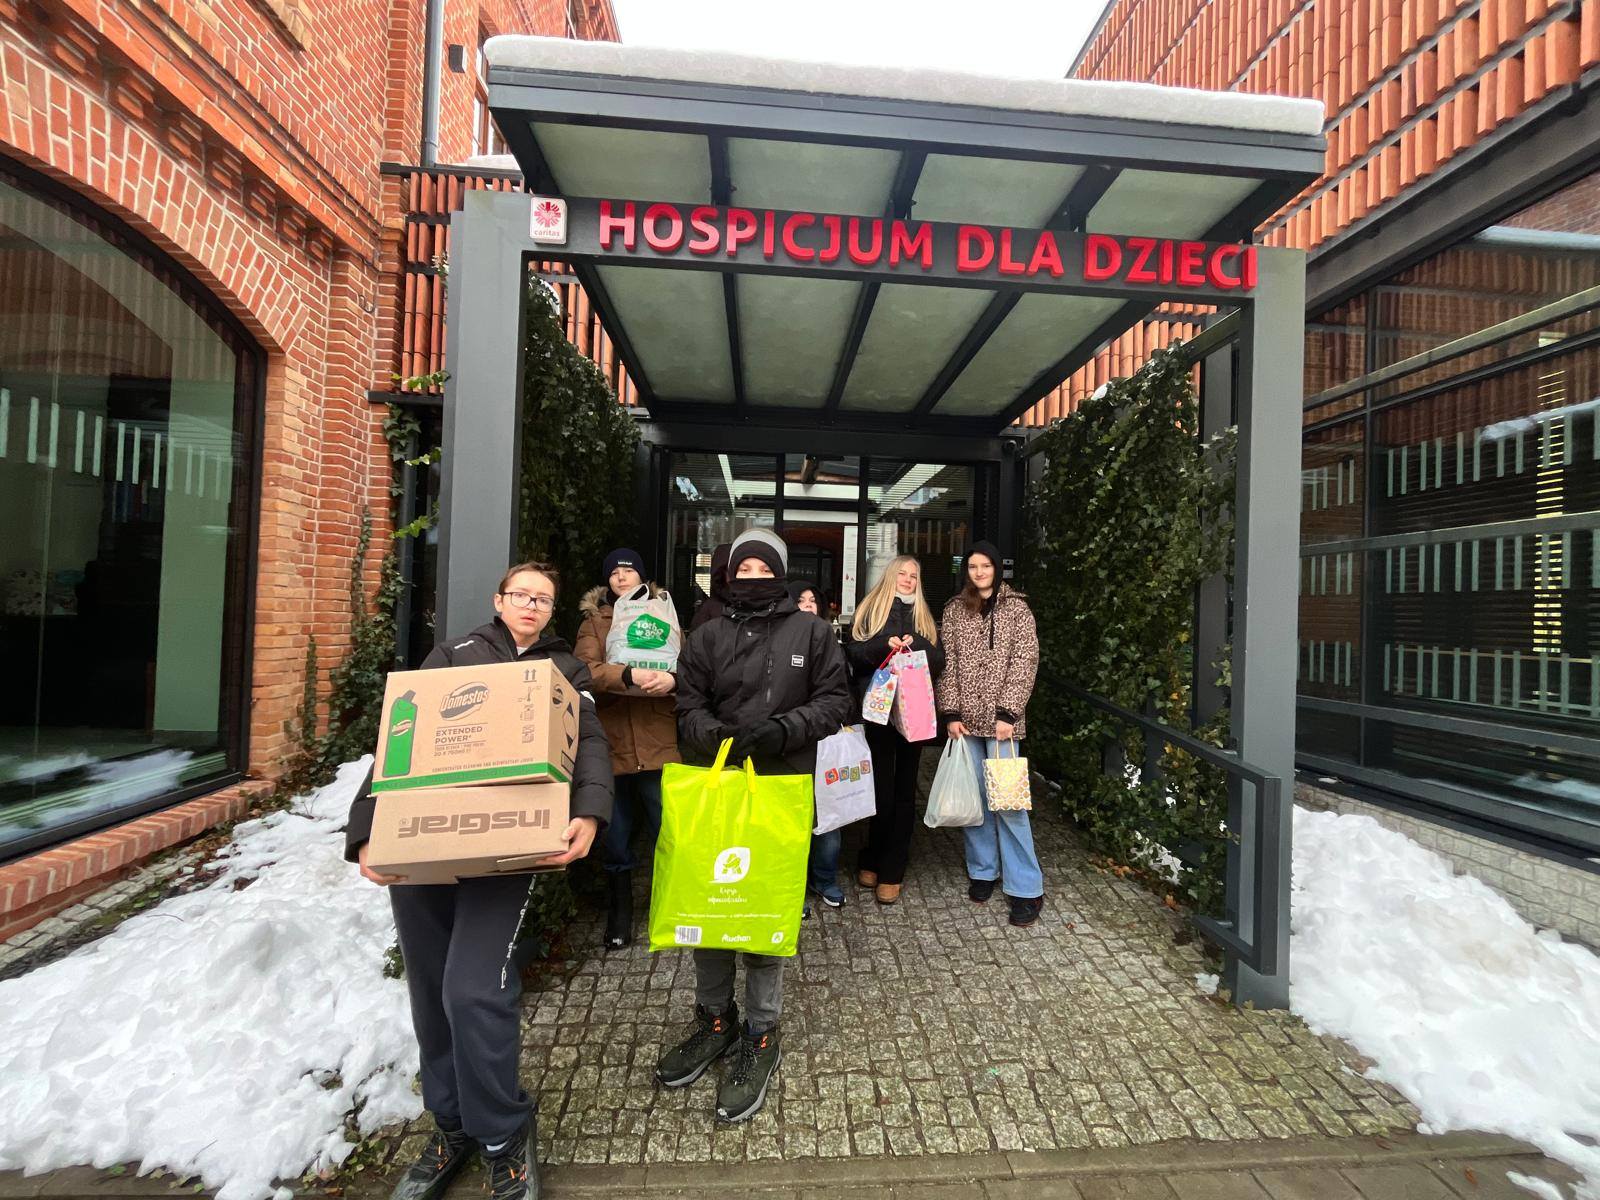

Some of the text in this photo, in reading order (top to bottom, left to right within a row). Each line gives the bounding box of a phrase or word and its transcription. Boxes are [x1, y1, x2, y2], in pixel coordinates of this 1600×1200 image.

[599, 200, 1259, 291] HOSPICJUM DLA DZIECI
[439, 689, 489, 712] Domestos
[435, 726, 483, 737] EXTENDED
[398, 809, 551, 839] insGraf
[721, 932, 751, 943] Auchan
